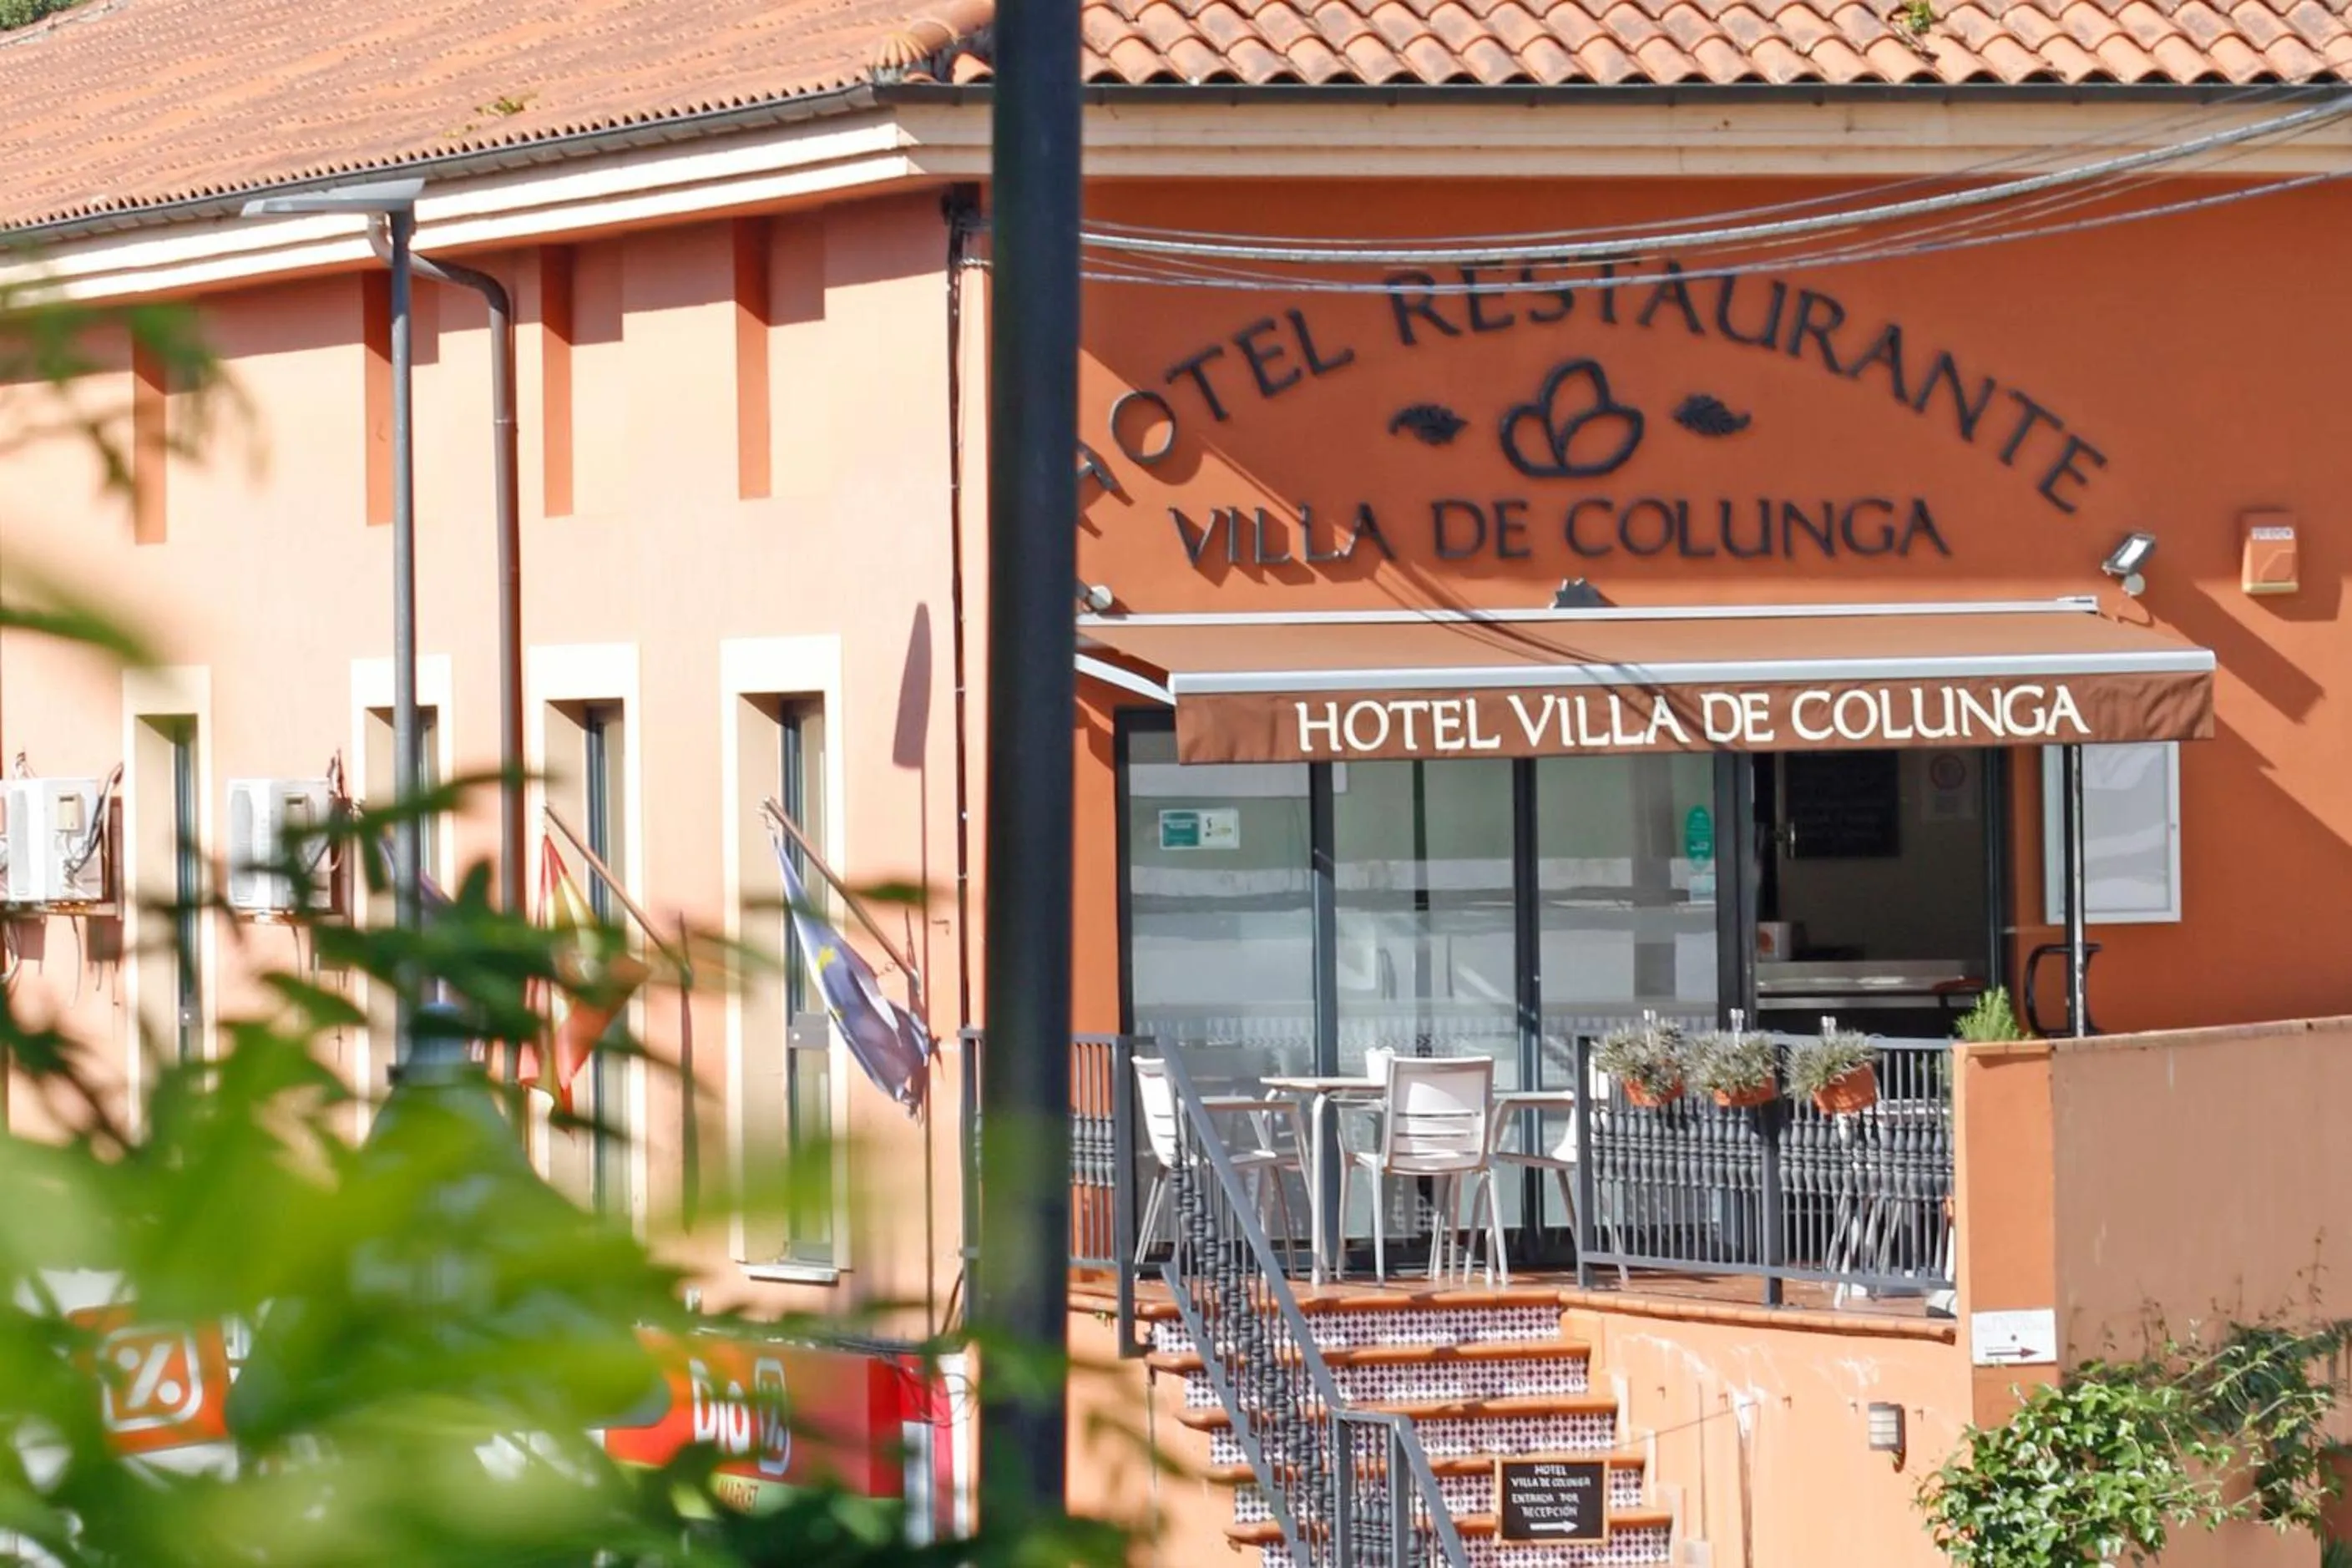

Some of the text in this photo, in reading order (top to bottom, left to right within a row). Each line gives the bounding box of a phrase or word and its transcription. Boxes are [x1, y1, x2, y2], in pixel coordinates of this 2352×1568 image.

[1383, 253, 2109, 515] RESTAURANTE
[1169, 498, 1953, 568] VILLA DE COLUNGA
[1295, 685, 2092, 752] HOTEL VILLA DE COLUNGA
[1510, 1477, 1538, 1488] VILLA
[1534, 1464, 1567, 1476] HOTEL
[1511, 1493, 1580, 1504] ENTRADA POR
